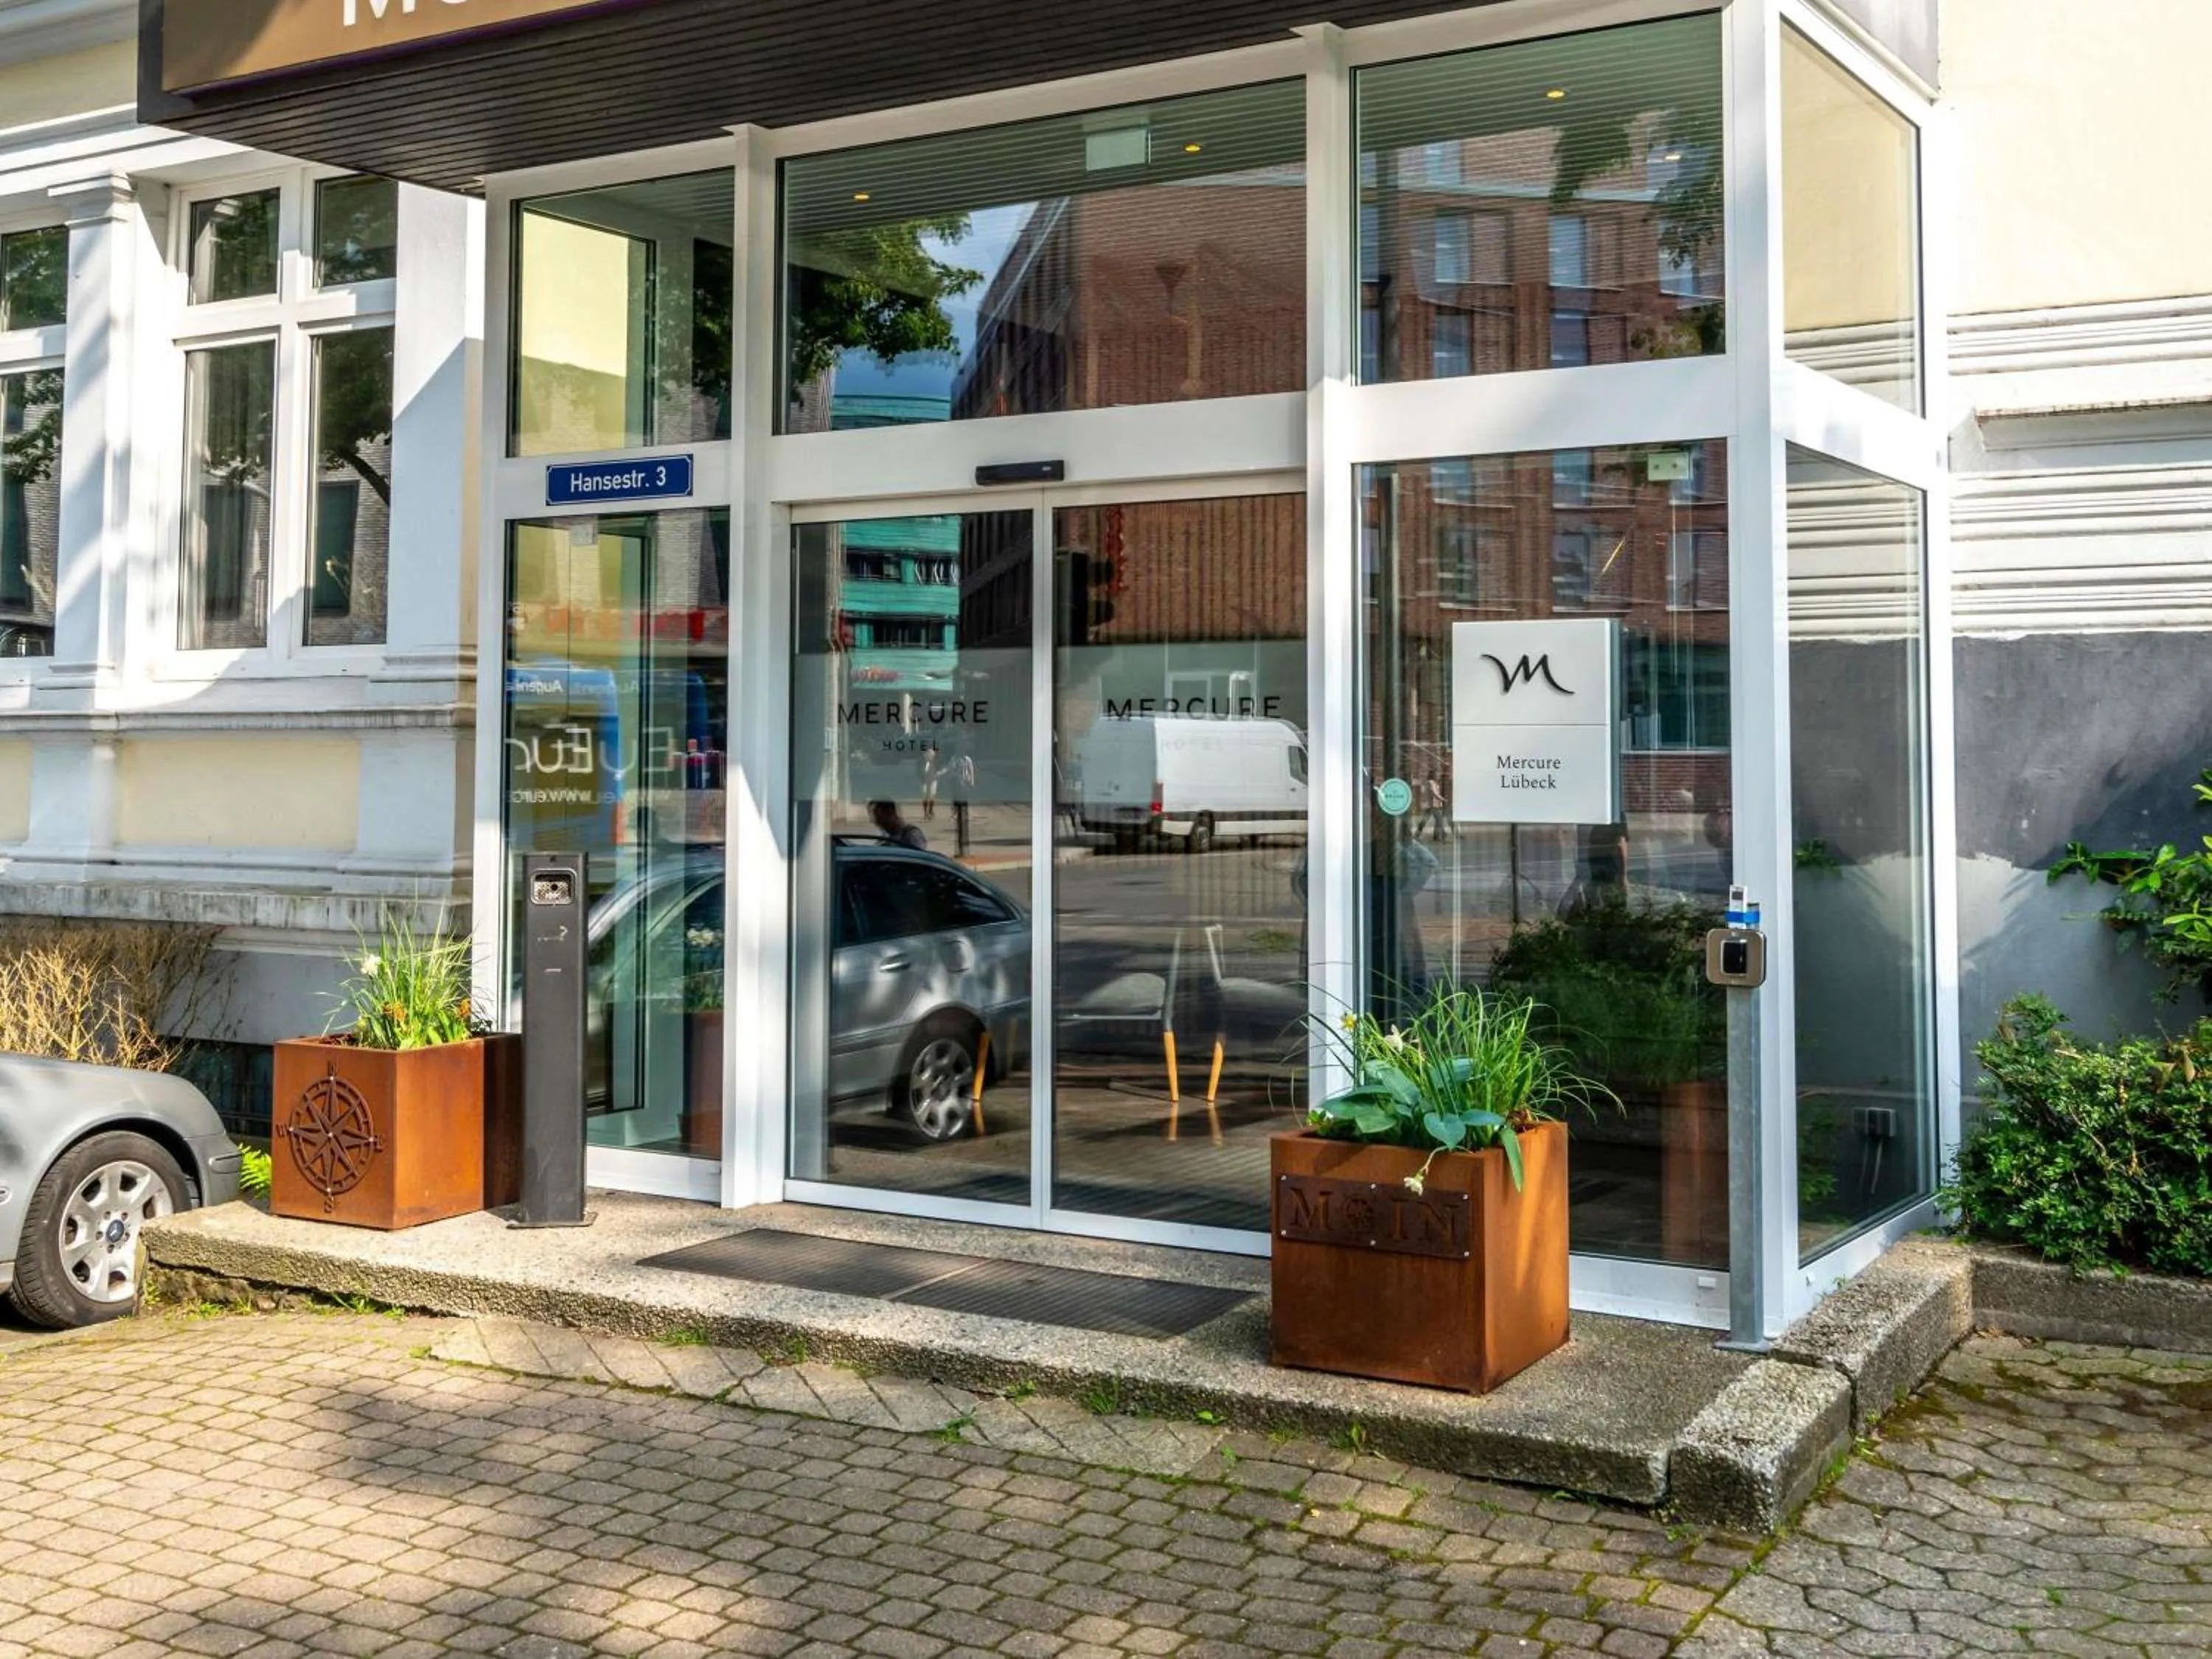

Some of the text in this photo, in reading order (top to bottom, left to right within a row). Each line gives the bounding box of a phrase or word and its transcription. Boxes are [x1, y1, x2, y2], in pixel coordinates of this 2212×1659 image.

[570, 466, 667, 493] Hansestr. 3
[838, 700, 989, 724] MERCURE
[1106, 695, 1282, 722] MERCURE
[883, 739, 939, 751] HOTEL
[1496, 754, 1562, 770] Mercure
[1500, 773, 1557, 789] Lübeck
